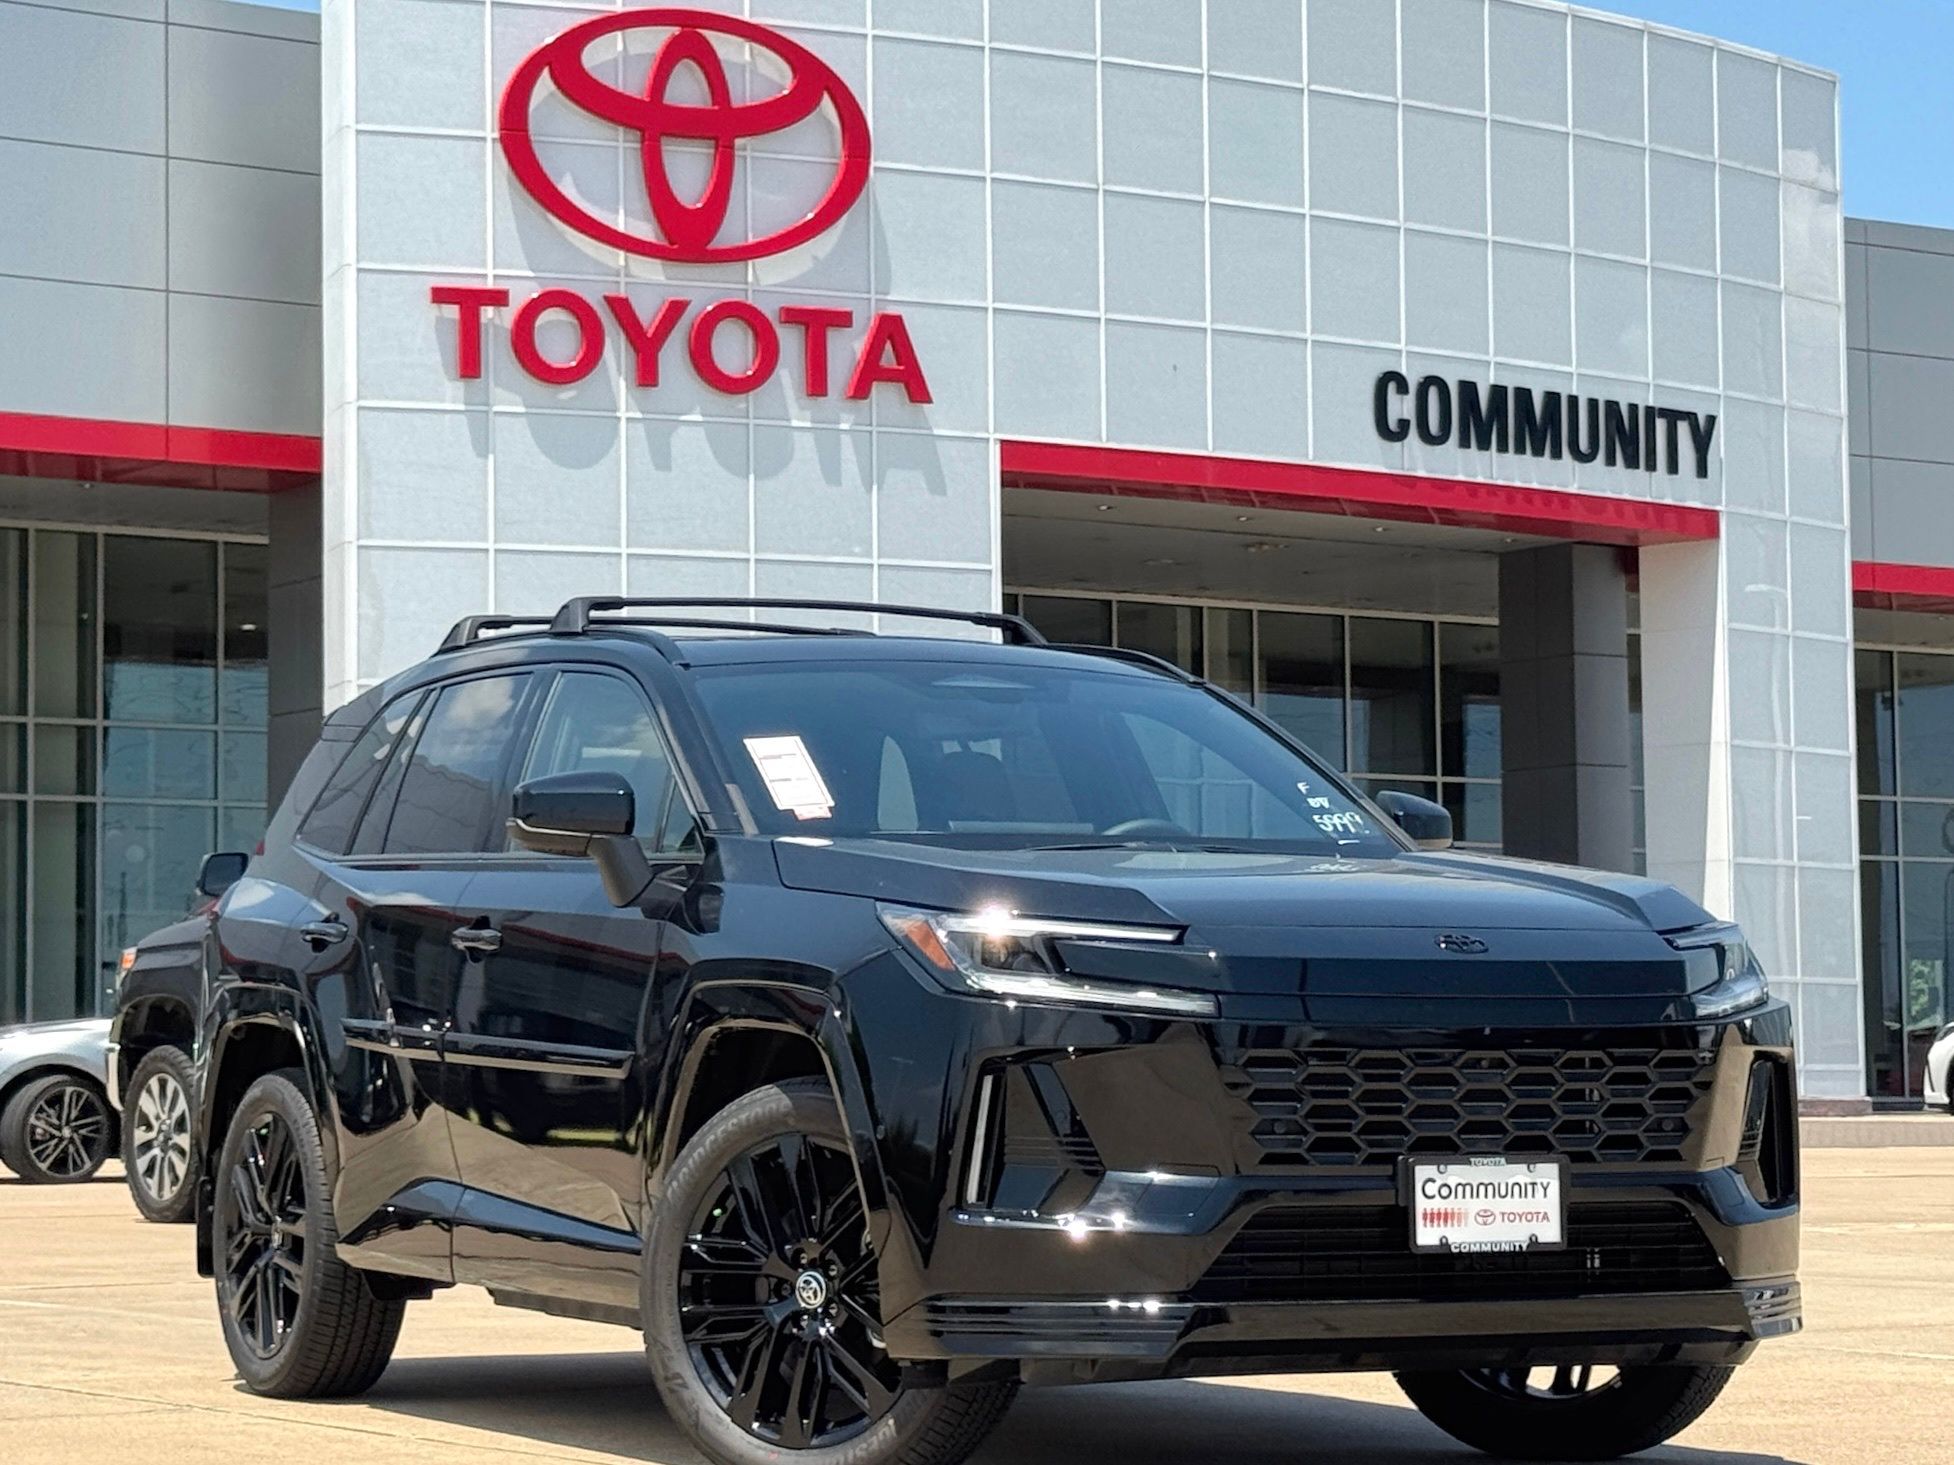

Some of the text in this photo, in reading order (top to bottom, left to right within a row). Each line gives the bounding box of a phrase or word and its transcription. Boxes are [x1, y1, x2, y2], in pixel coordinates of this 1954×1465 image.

[430, 286, 934, 404] TOYOTA
[1374, 370, 1718, 479] COMMUNITY
[1500, 1211, 1550, 1223] TOYOTA
[1450, 1242, 1529, 1253] COMMUNITY
